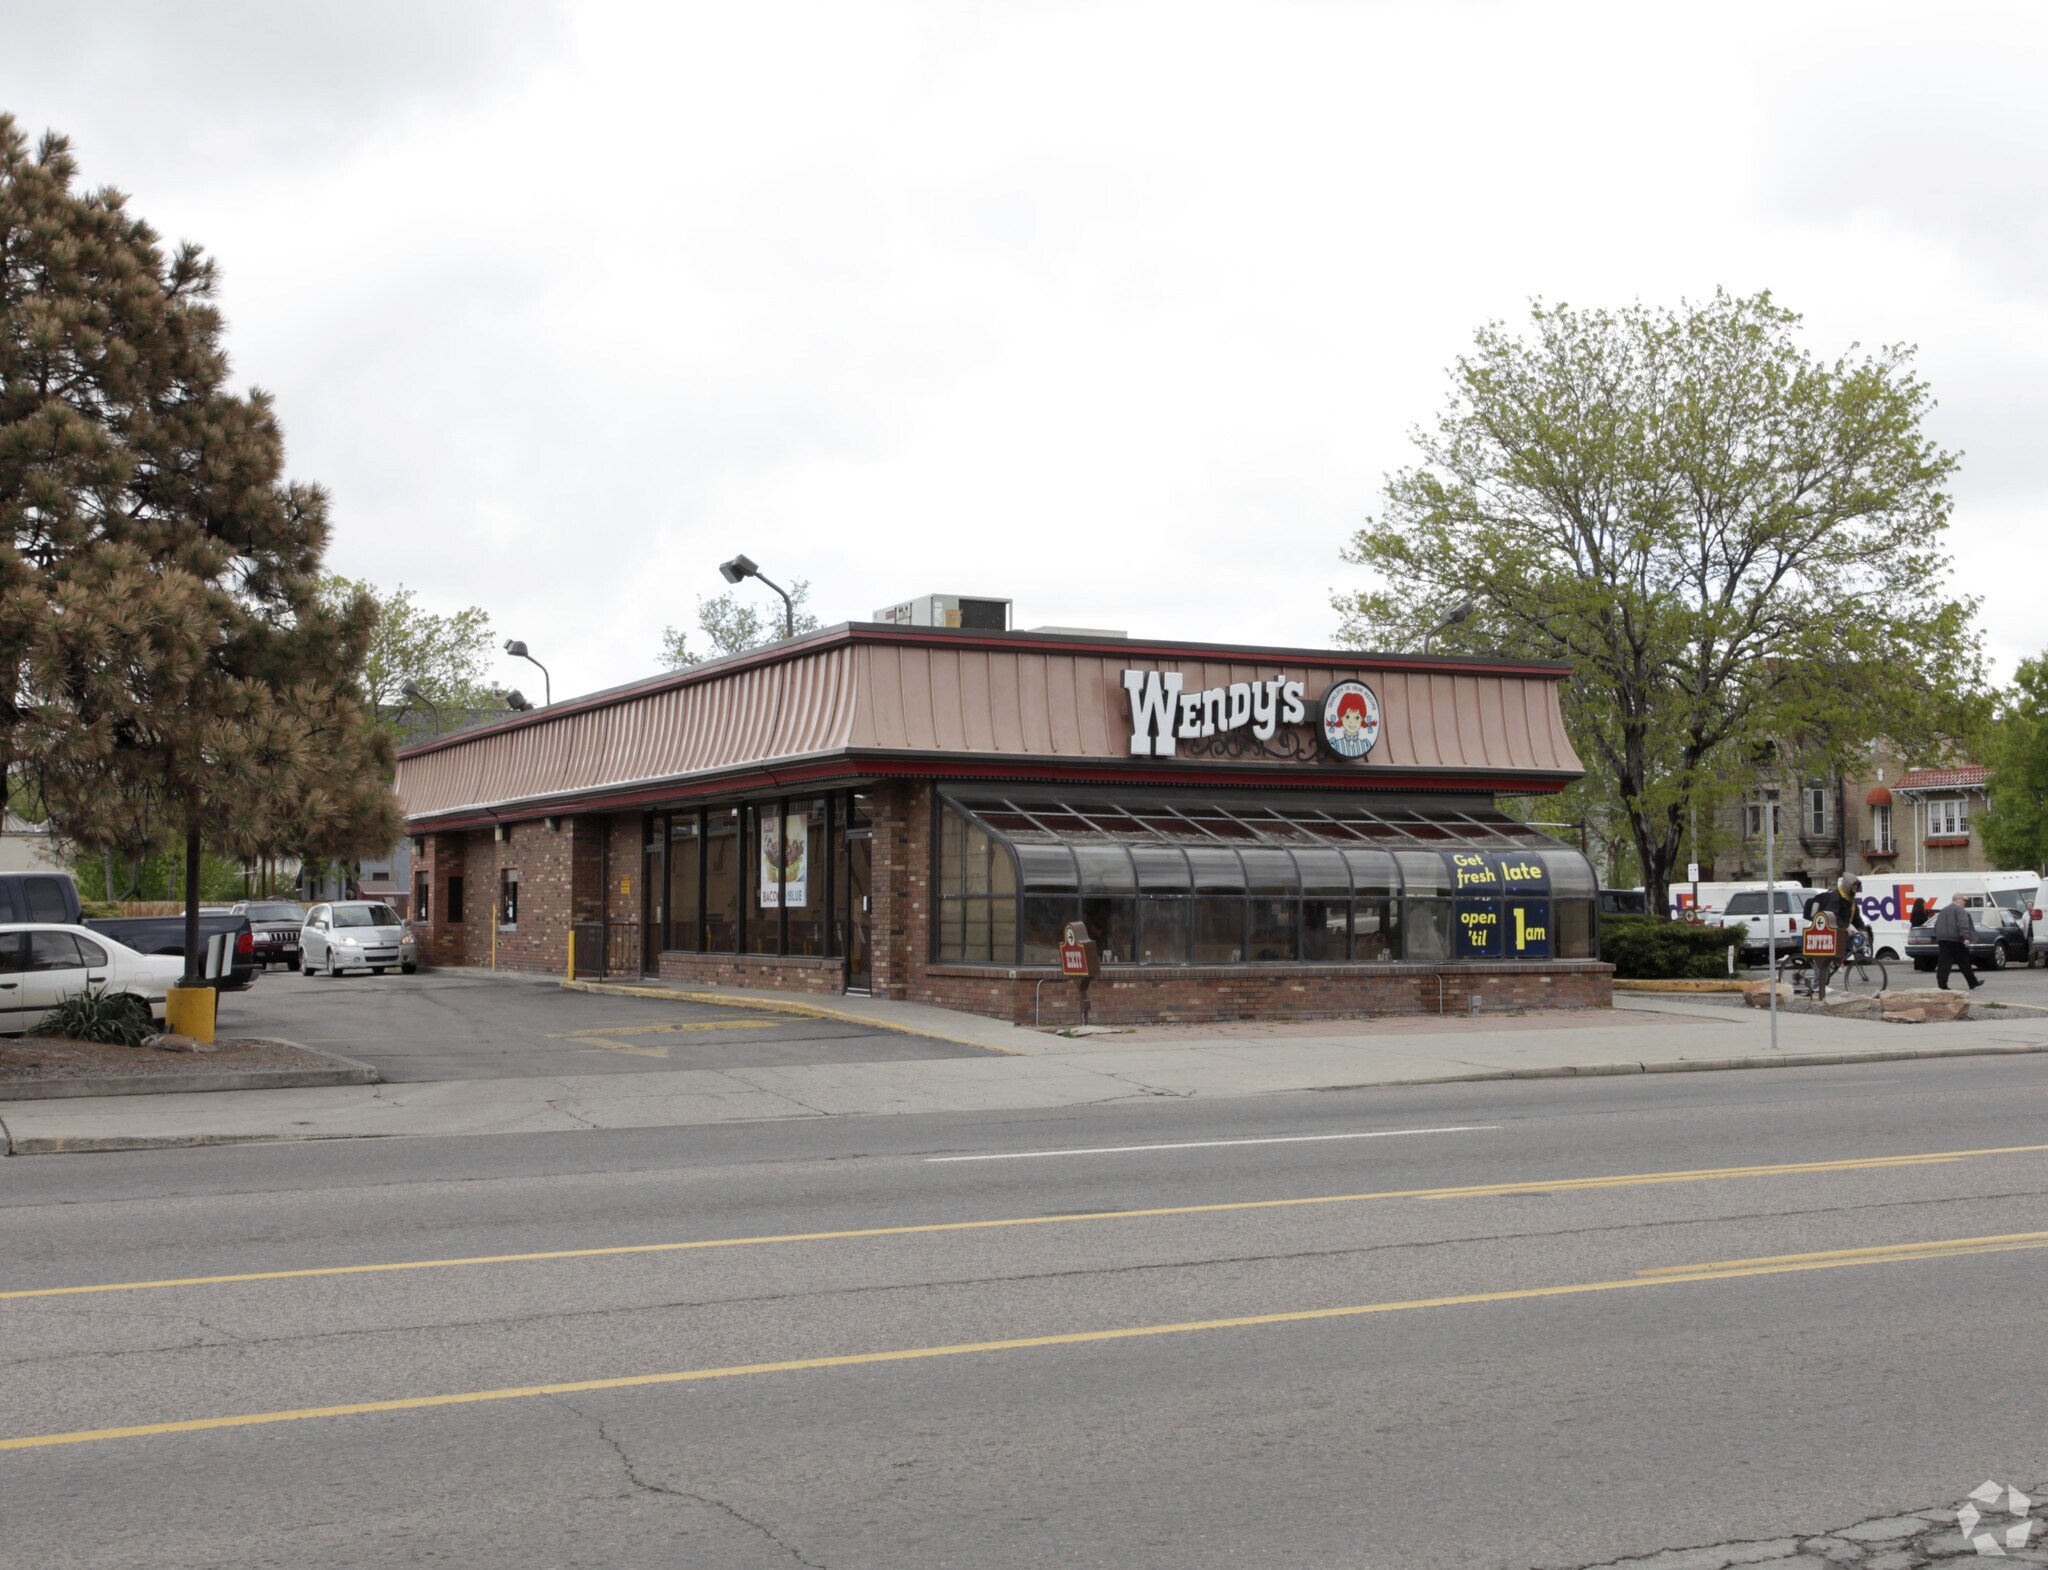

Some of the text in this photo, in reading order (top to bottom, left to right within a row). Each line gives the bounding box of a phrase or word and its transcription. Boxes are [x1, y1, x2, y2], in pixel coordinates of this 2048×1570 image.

[1328, 688, 1344, 708] QUALITY
[1352, 685, 1364, 693] OUR
[1364, 692, 1377, 711] RECIPE
[1453, 854, 1484, 867] Get
[1457, 862, 1542, 889] fresh late
[1461, 913, 1497, 928] open
[1468, 930, 1487, 946] 'til
[1806, 934, 1834, 950] ENTER
[1065, 950, 1083, 968] EXIT
